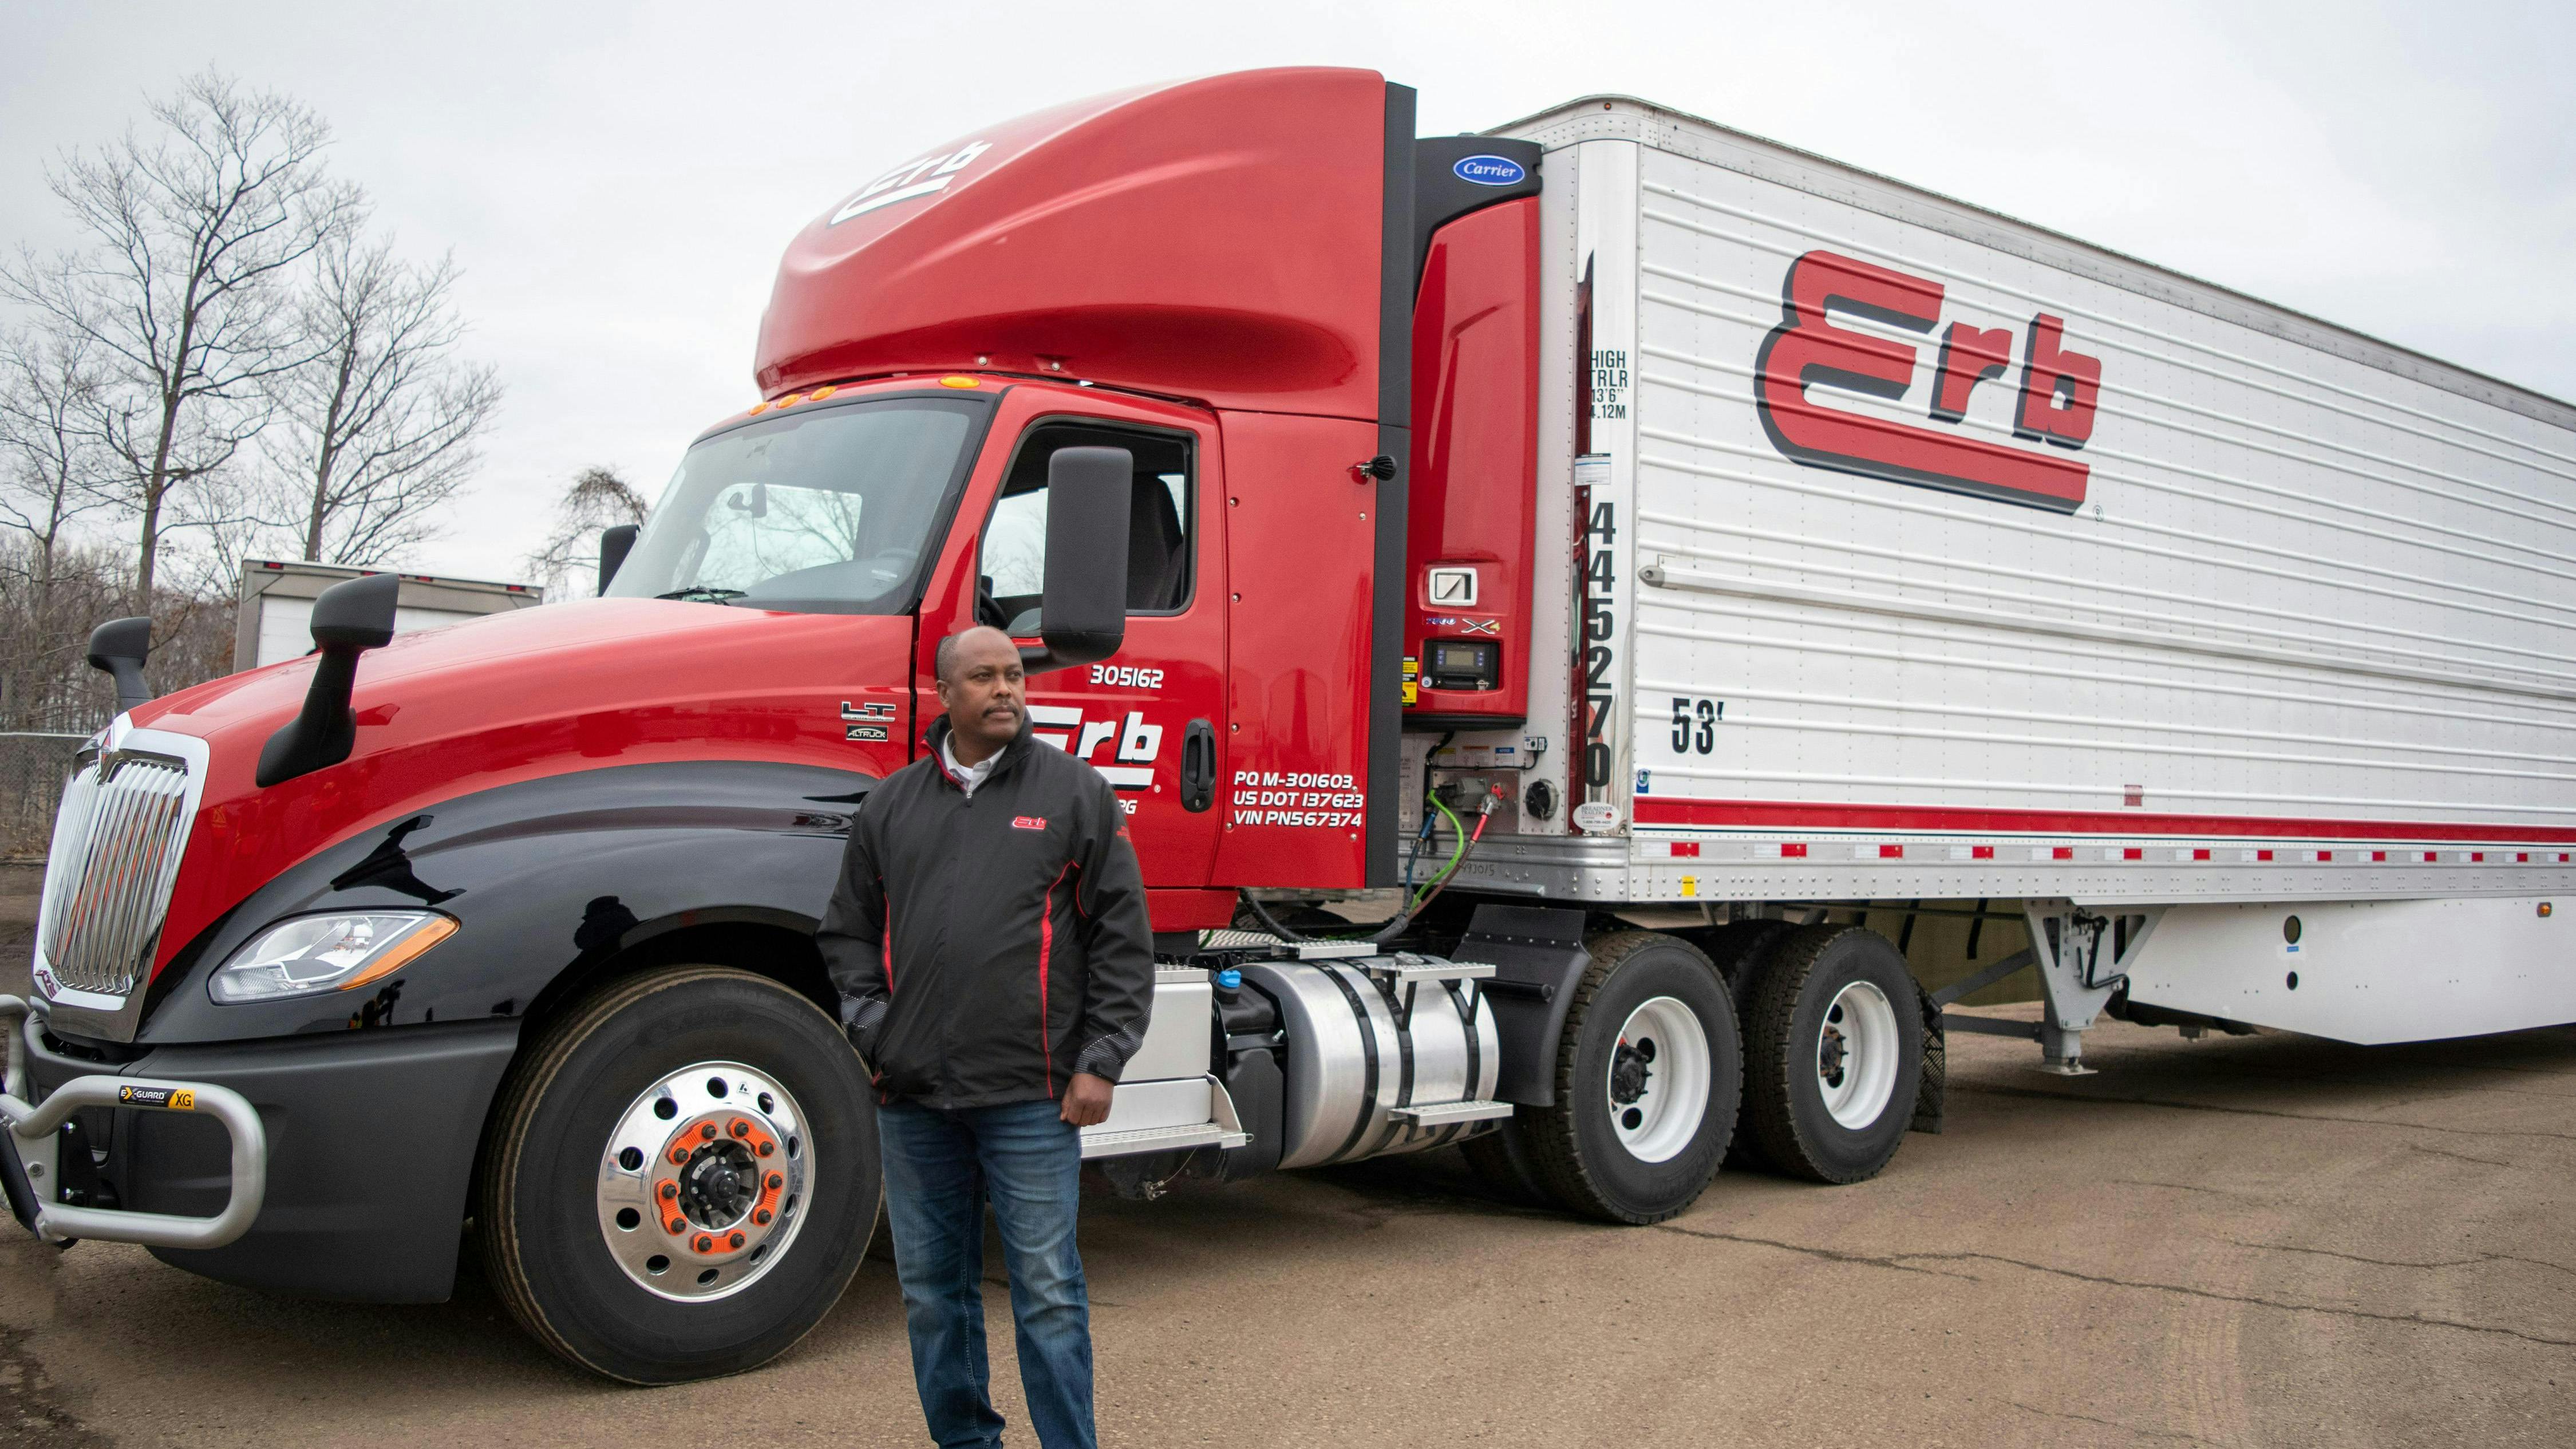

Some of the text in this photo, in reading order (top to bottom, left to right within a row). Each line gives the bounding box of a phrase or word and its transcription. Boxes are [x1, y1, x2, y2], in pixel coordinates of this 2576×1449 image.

[1463, 162, 1516, 177] Carrier
[1590, 350, 1625, 368] HIGH
[1587, 369, 1627, 387] TRLR
[1753, 250, 2102, 515] Erb
[1591, 404, 1625, 419] 4.12M
[1586, 502, 1617, 788] 445270
[1090, 665, 1164, 689] 305162
[841, 701, 896, 716] LT
[848, 729, 886, 738] ALTRUCK
[1672, 697, 1724, 755] 53'
[1234, 771, 1353, 789] PQ M-301603
[1233, 791, 1364, 808] US DOT 137623
[1012, 816, 1047, 830] Erb
[1234, 810, 1362, 827] VIN PN567374
[175, 1093, 192, 1107] XG
